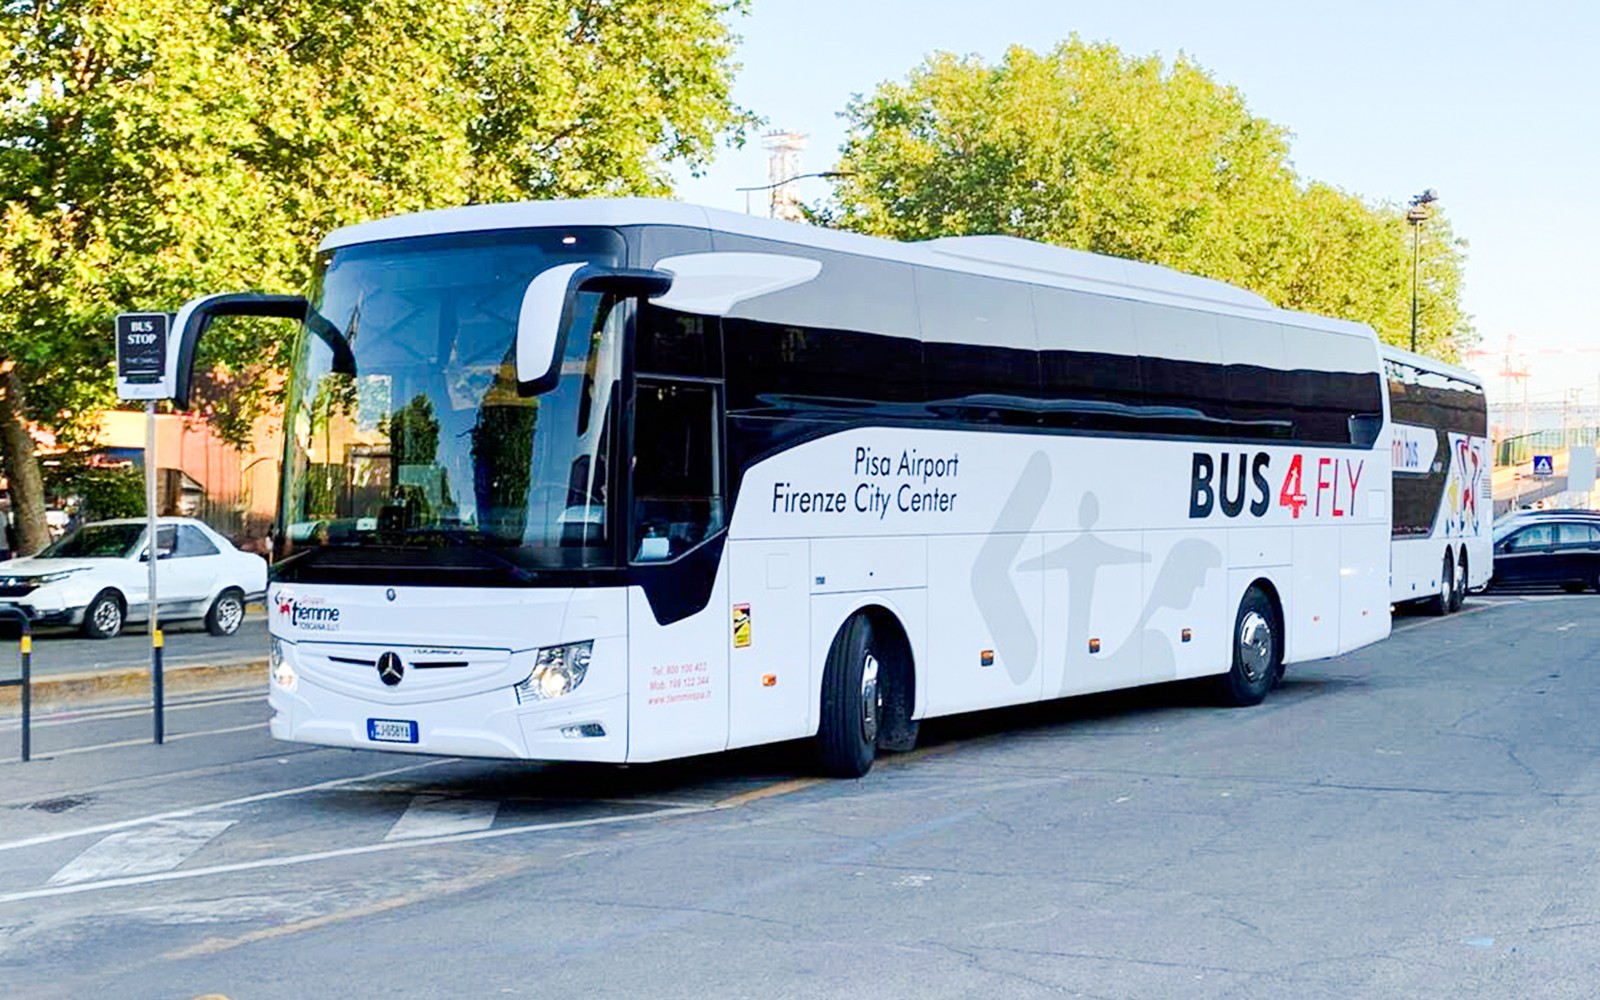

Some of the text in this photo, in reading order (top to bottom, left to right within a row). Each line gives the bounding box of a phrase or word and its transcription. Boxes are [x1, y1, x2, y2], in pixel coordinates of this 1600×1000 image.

[127, 334, 158, 345] STOP
[131, 321, 154, 332] BUS
[854, 446, 959, 485] Pisa Airport
[772, 482, 957, 520] Firenze City Center
[1189, 452, 1364, 519] BUS 4 FLY
[292, 601, 340, 626] tiemme
